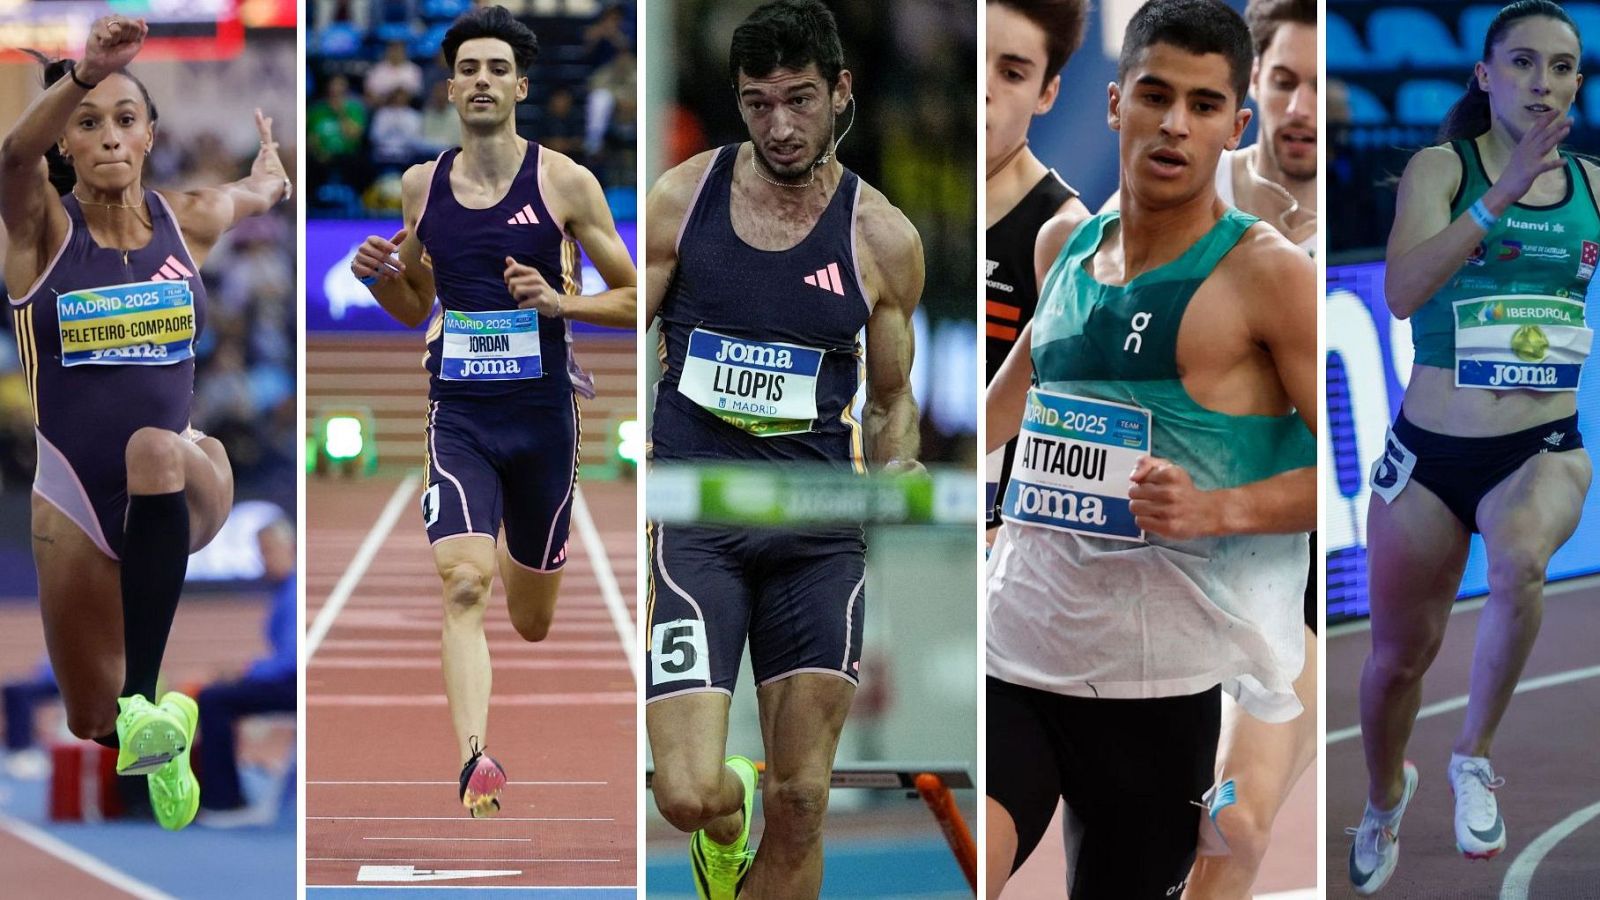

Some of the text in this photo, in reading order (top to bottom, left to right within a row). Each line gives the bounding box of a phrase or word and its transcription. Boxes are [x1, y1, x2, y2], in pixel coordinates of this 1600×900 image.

[61, 291, 159, 316] MADRID 2025
[1506, 307, 1571, 322] IBERDROLA
[61, 314, 193, 343] PELETEIRO-COMPAORE
[447, 319, 484, 330] MADRID
[486, 318, 512, 329] 2025
[469, 334, 510, 353] JORDAN
[713, 365, 785, 402] LLOPIS
[732, 401, 778, 415] MADRID
[1062, 410, 1108, 435] 2025
[1022, 436, 1107, 481] ATTAOUI
[660, 625, 698, 674] 5
